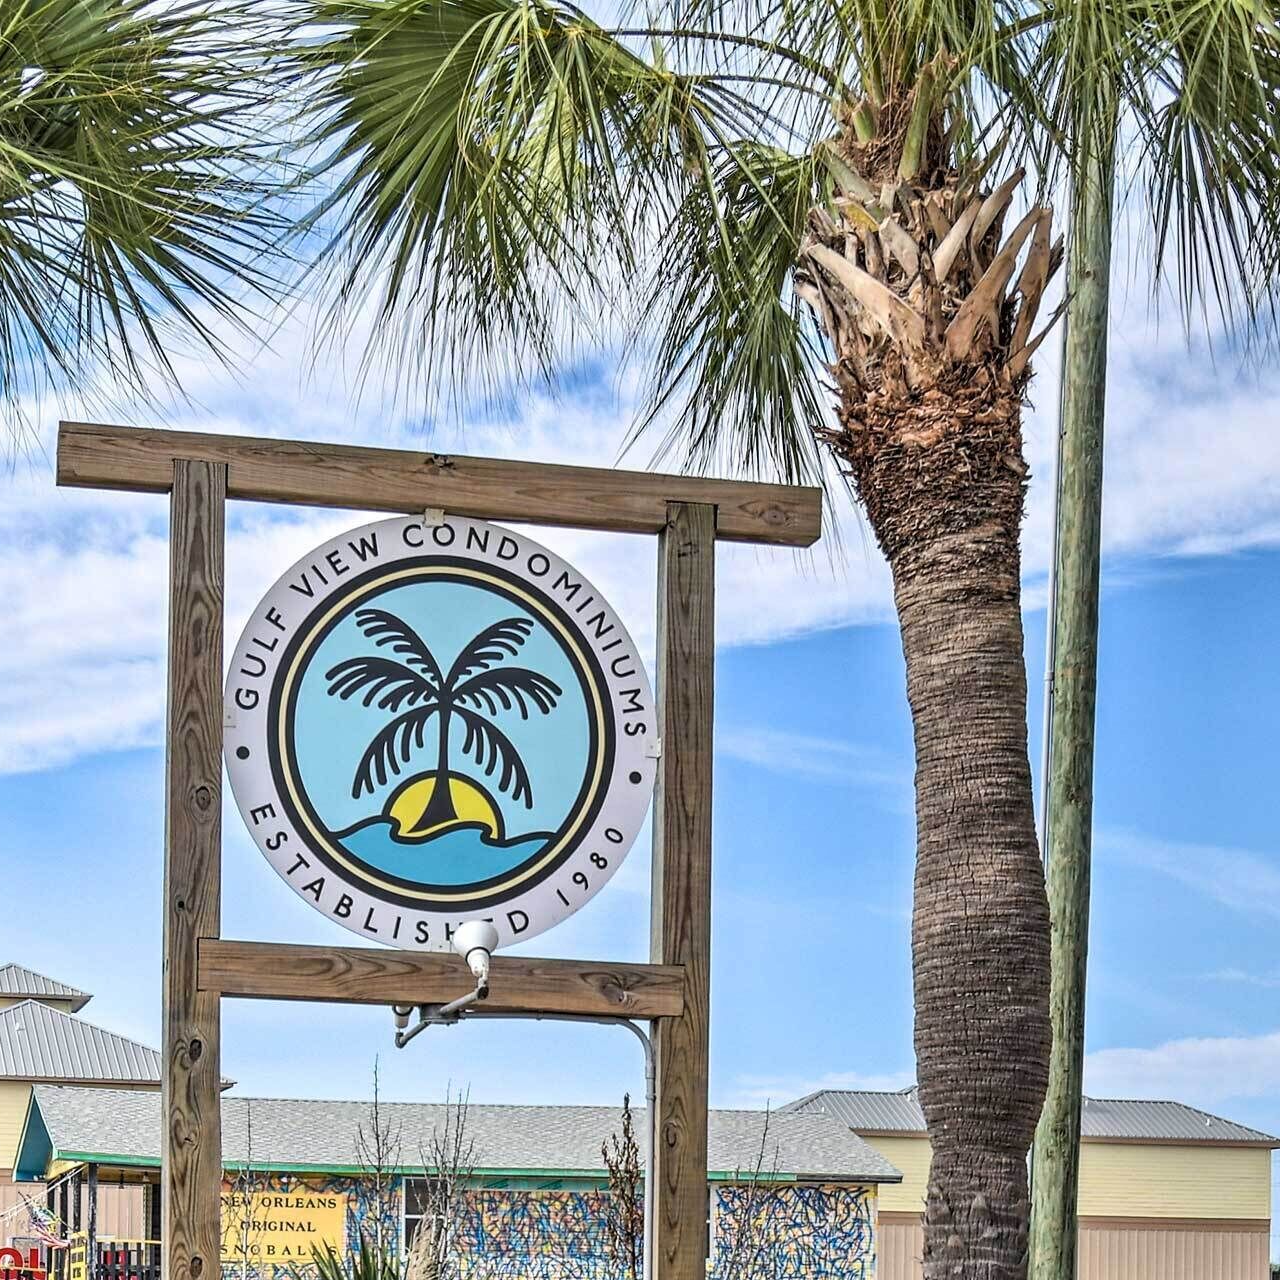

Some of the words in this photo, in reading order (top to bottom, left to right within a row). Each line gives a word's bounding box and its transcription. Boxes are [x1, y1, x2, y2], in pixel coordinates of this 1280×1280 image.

[235, 606, 287, 711] GULF
[289, 532, 380, 599] VIEW
[402, 523, 647, 738] CONDOMINIUMS
[250, 802, 530, 944] ESTABLISHD
[555, 826, 624, 907] 1980
[261, 1196, 337, 1209] ORLEANS
[240, 1220, 317, 1233] ORIGINAL
[220, 1243, 337, 1256] SNOBALS
